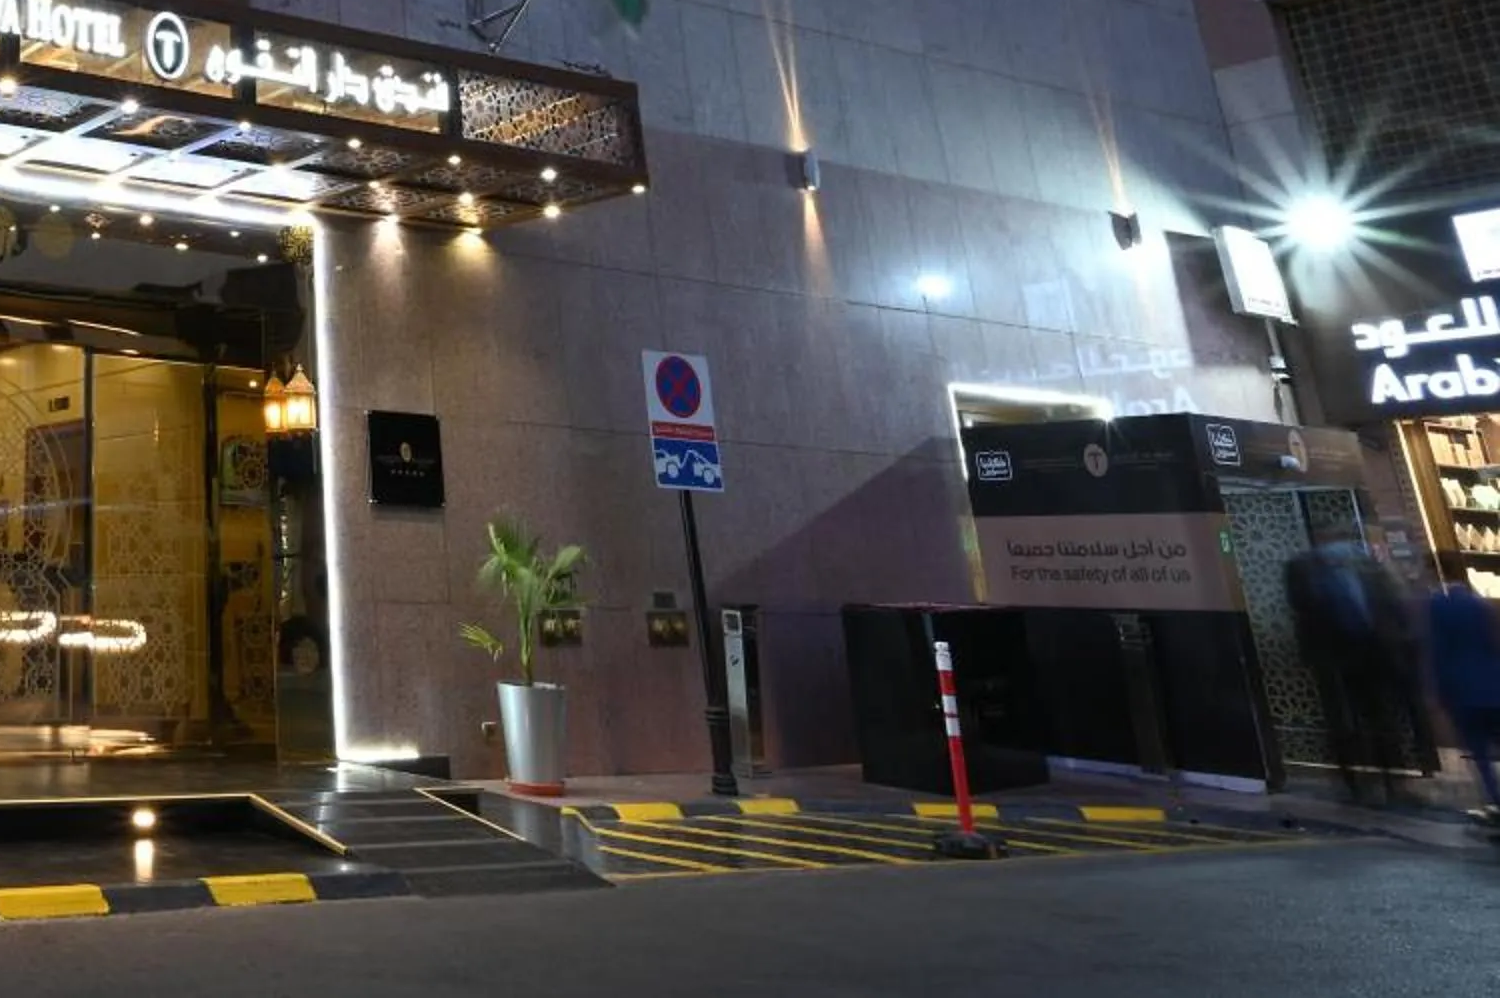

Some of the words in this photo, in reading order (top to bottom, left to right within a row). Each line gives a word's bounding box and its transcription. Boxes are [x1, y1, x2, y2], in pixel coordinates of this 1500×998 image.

[325, 51, 370, 106] دار
[371, 64, 449, 114] فندق
[1371, 353, 1500, 405] Arab
[1011, 565, 1035, 581] For
[1038, 565, 1061, 581] the
[1062, 565, 1109, 584] safety
[1111, 566, 1128, 582] of
[1130, 566, 1149, 582] all
[1152, 566, 1168, 583] of
